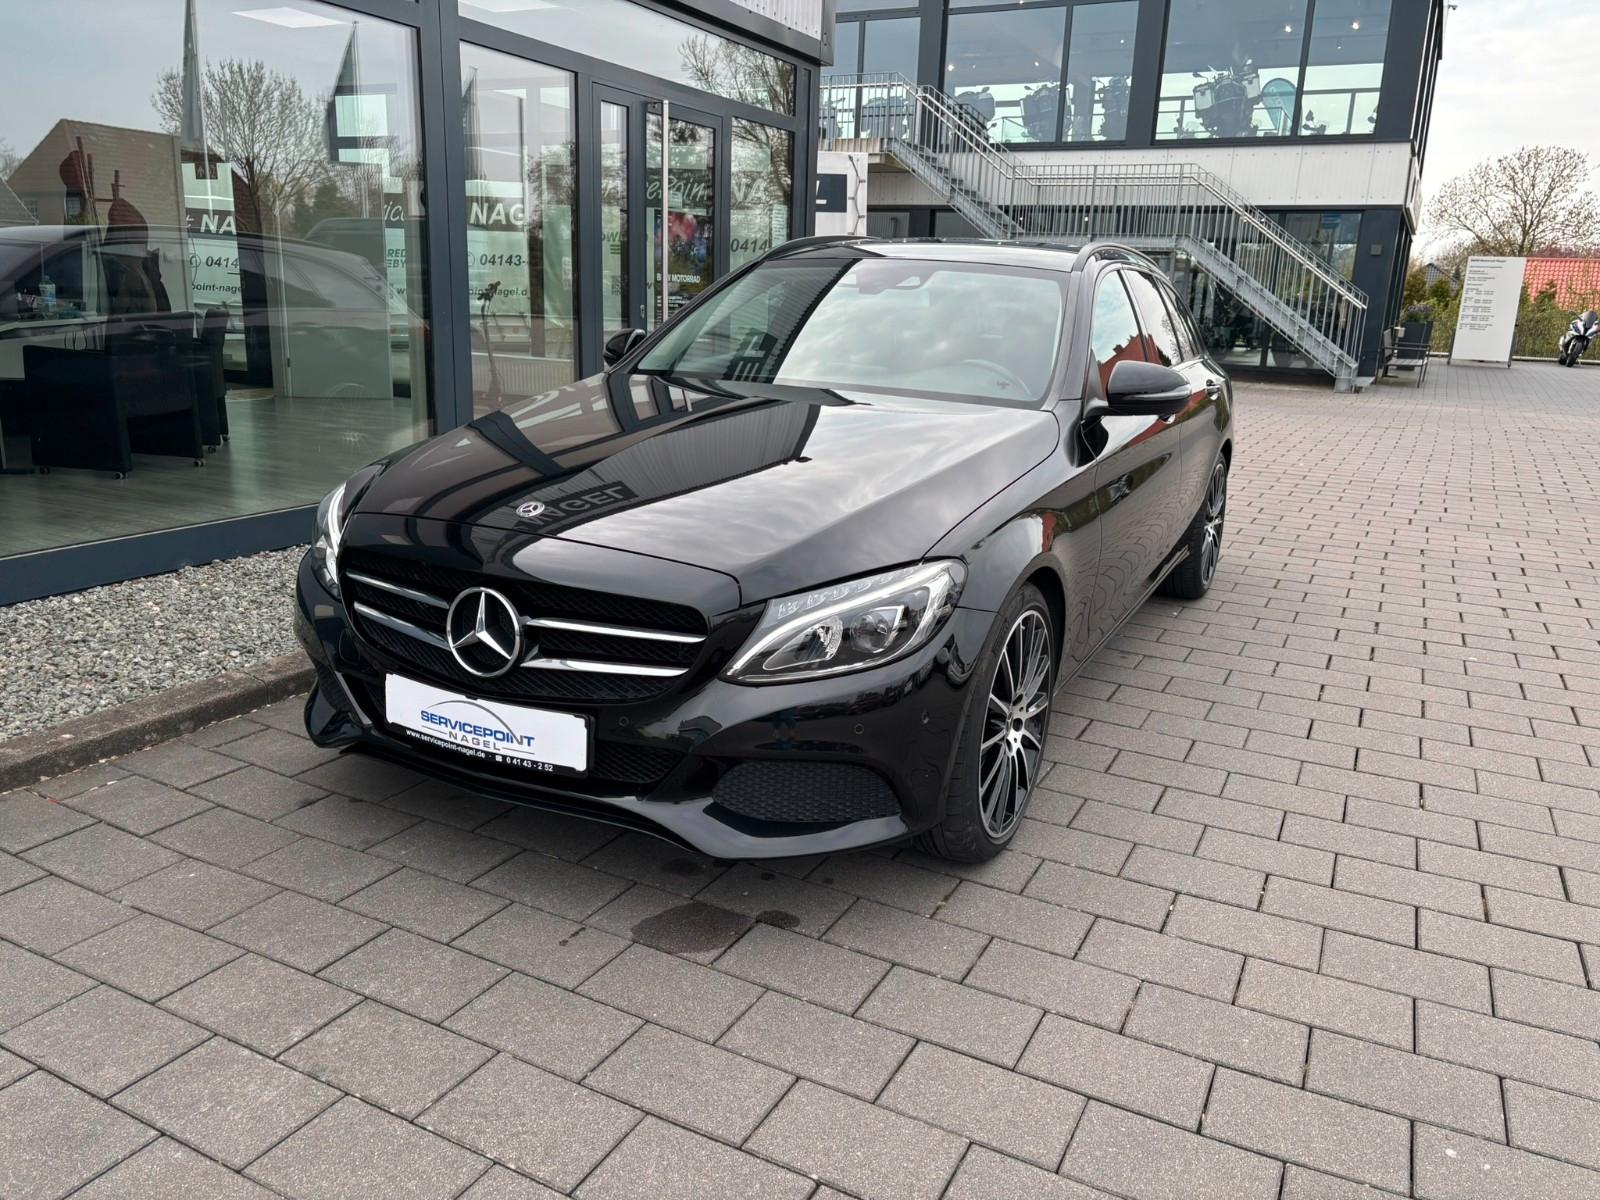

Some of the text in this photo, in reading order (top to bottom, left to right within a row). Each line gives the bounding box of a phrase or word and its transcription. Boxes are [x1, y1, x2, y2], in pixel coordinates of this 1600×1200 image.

[405, 728, 486, 759] www.servicepoint-nagel.de
[420, 710, 536, 747] SERVICEPOINT
[448, 731, 501, 751] NAGEL
